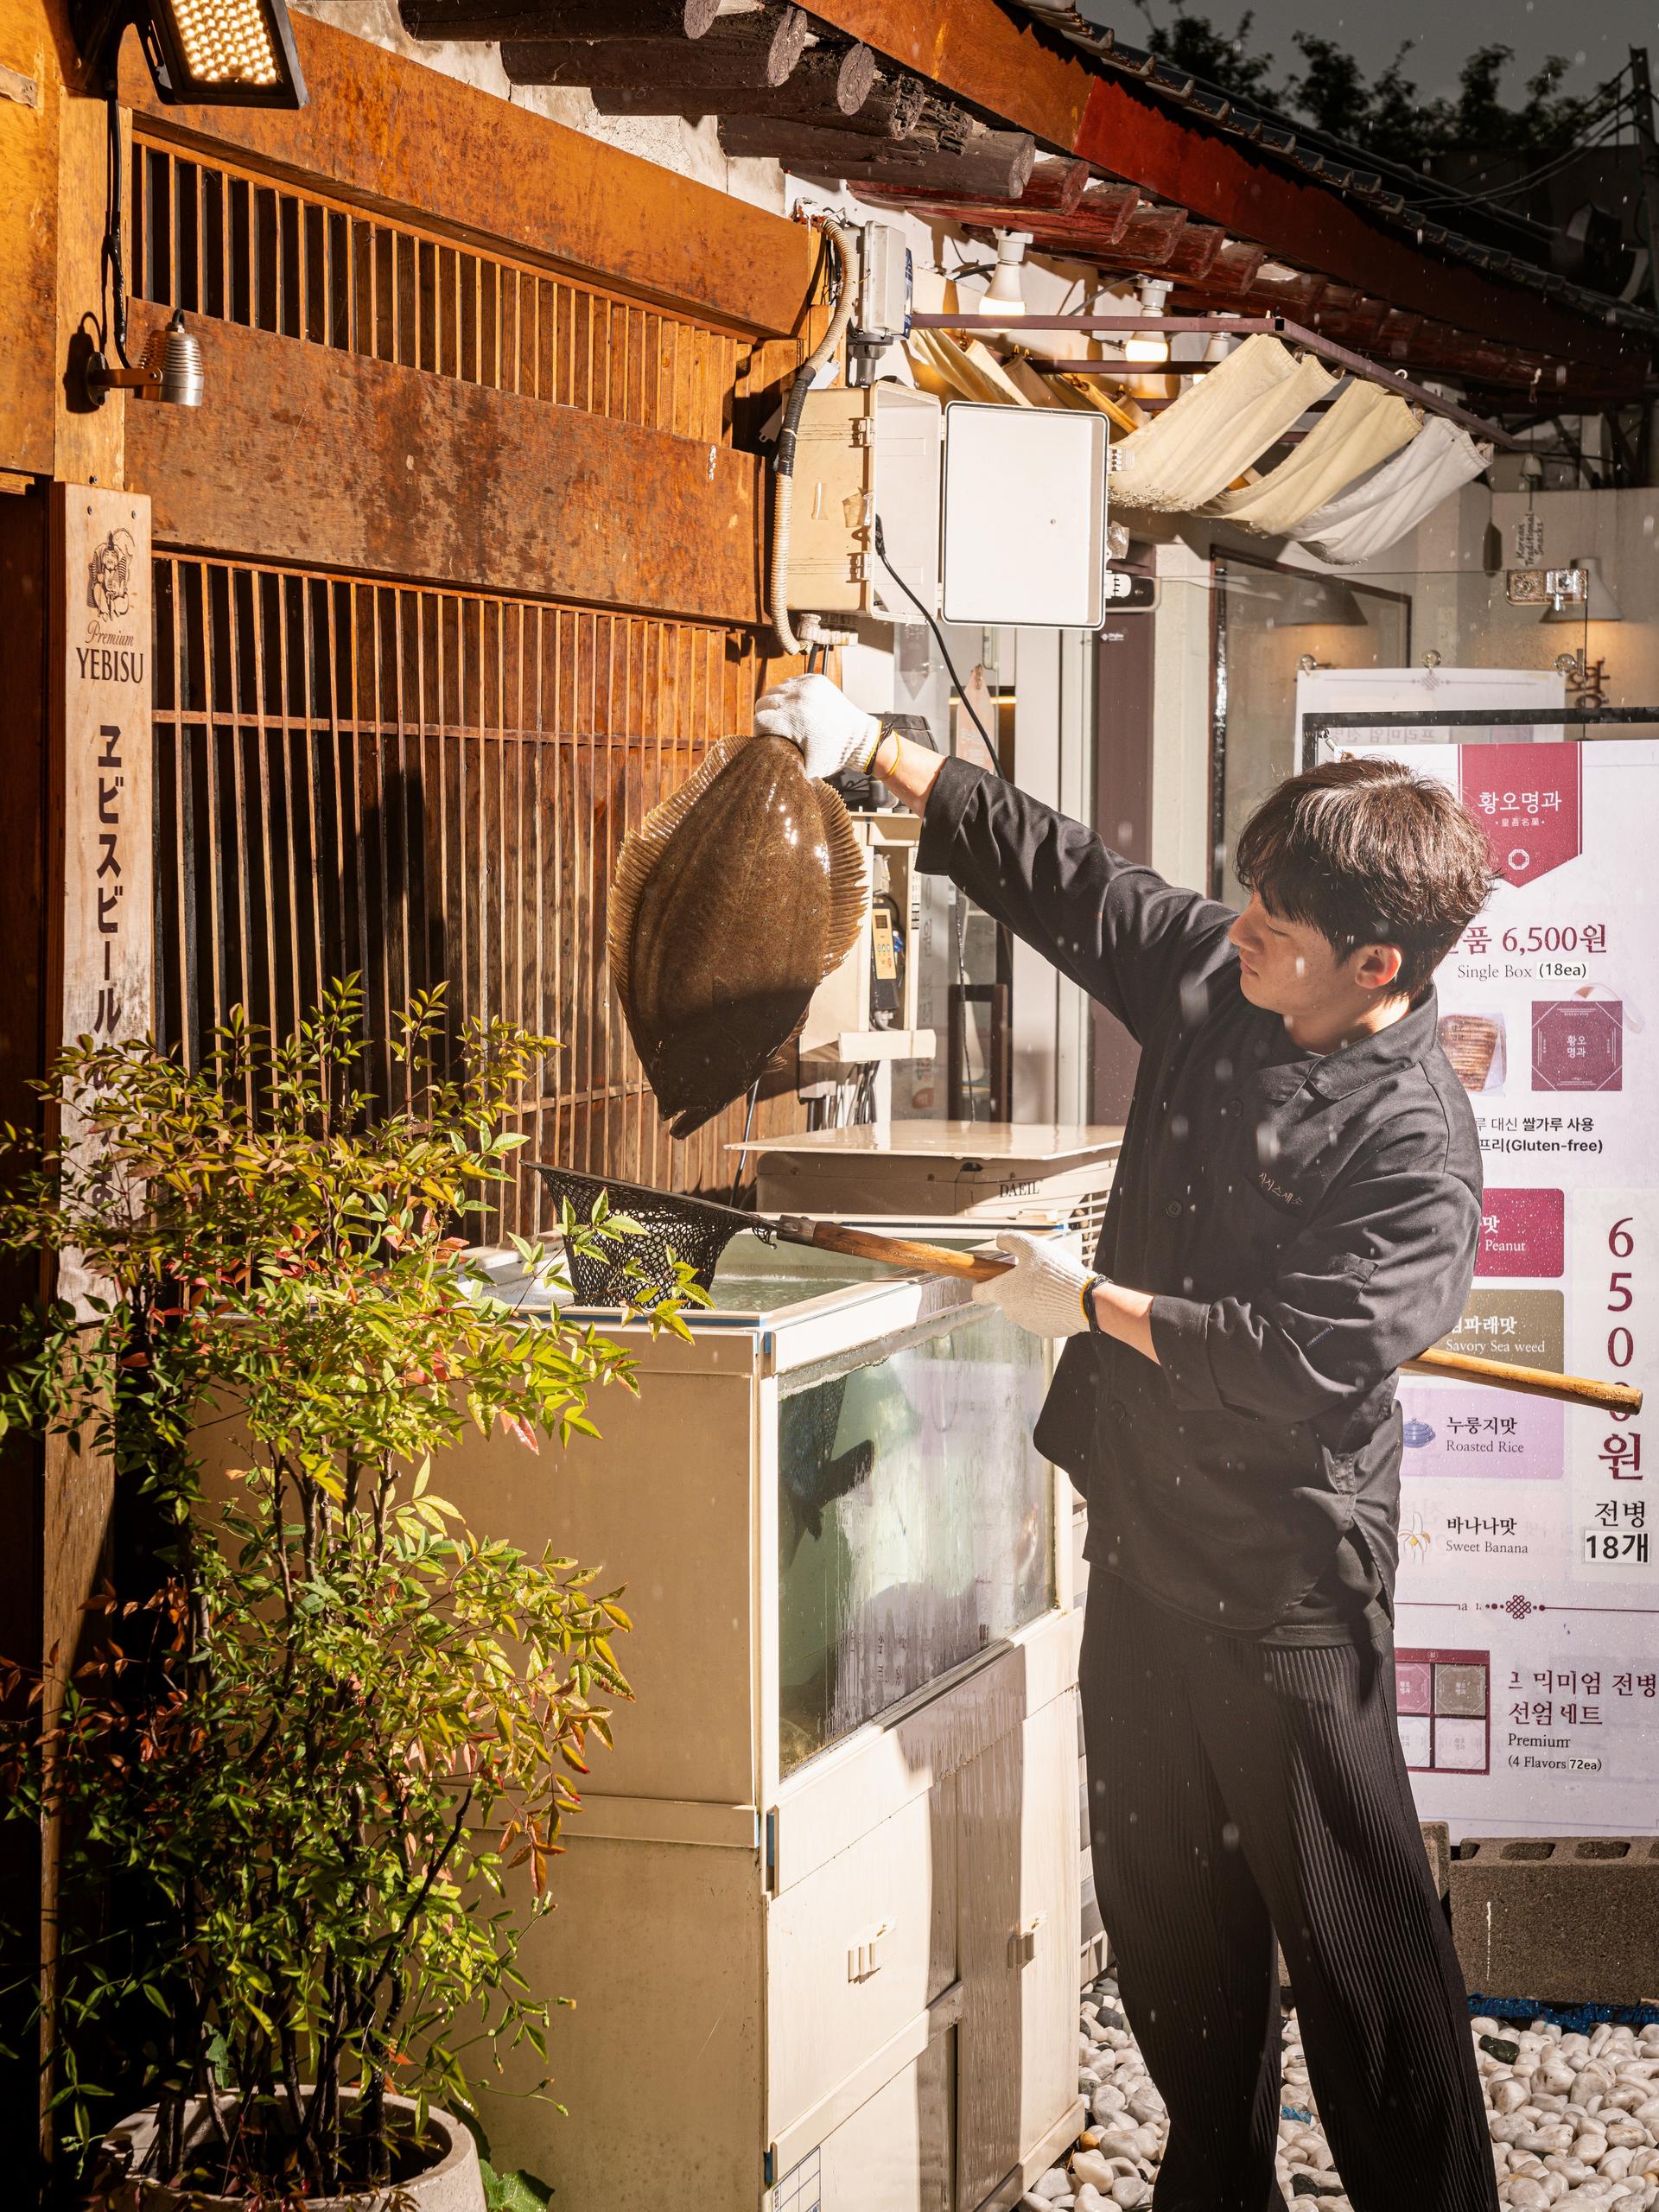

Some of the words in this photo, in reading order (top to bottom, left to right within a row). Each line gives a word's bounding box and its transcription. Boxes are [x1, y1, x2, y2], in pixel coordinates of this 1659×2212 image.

[1516, 524, 1525, 559] Korean
[1525, 512, 1535, 566] Traditional
[85, 620, 134, 647] Premium
[76, 647, 144, 683] YEBISU
[1478, 791, 1562, 814] 황오명과
[1448, 926, 1492, 955] 품
[1503, 925, 1607, 956] 6,500원
[1458, 964, 1499, 982] Single
[1505, 964, 1532, 978] Box
[1539, 963, 1586, 978] (18ea)
[1491, 1117, 1517, 1131] 대신
[1522, 1117, 1563, 1132] 쌀가루
[1567, 1117, 1594, 1132] 사용
[999, 1181, 1039, 1198] DAEIL
[1480, 1215, 1500, 1234] 맛
[1485, 1239, 1526, 1252] Peanut
[1446, 1339, 1486, 1354] Savory
[1491, 1340, 1510, 1352] Sea
[1515, 1341, 1545, 1353] weed
[1446, 1417, 1517, 1435] 누룽지맛
[1446, 1440, 1493, 1452] Roasted
[1498, 1441, 1524, 1452] Rice
[1594, 1500, 1645, 1529] 전병
[1446, 1516, 1517, 1535] 바나나맛
[1446, 1541, 1479, 1552] Sweet
[1484, 1541, 1529, 1554] Banana
[1586, 1533, 1649, 1563] 18개
[1611, 1672, 1656, 1698] 전병
[1508, 1733, 1571, 1748] Premium
[1508, 1755, 1520, 1768] (4
[1524, 1757, 1566, 1769] Flavors
[1569, 1758, 1602, 1771] 72ea)
